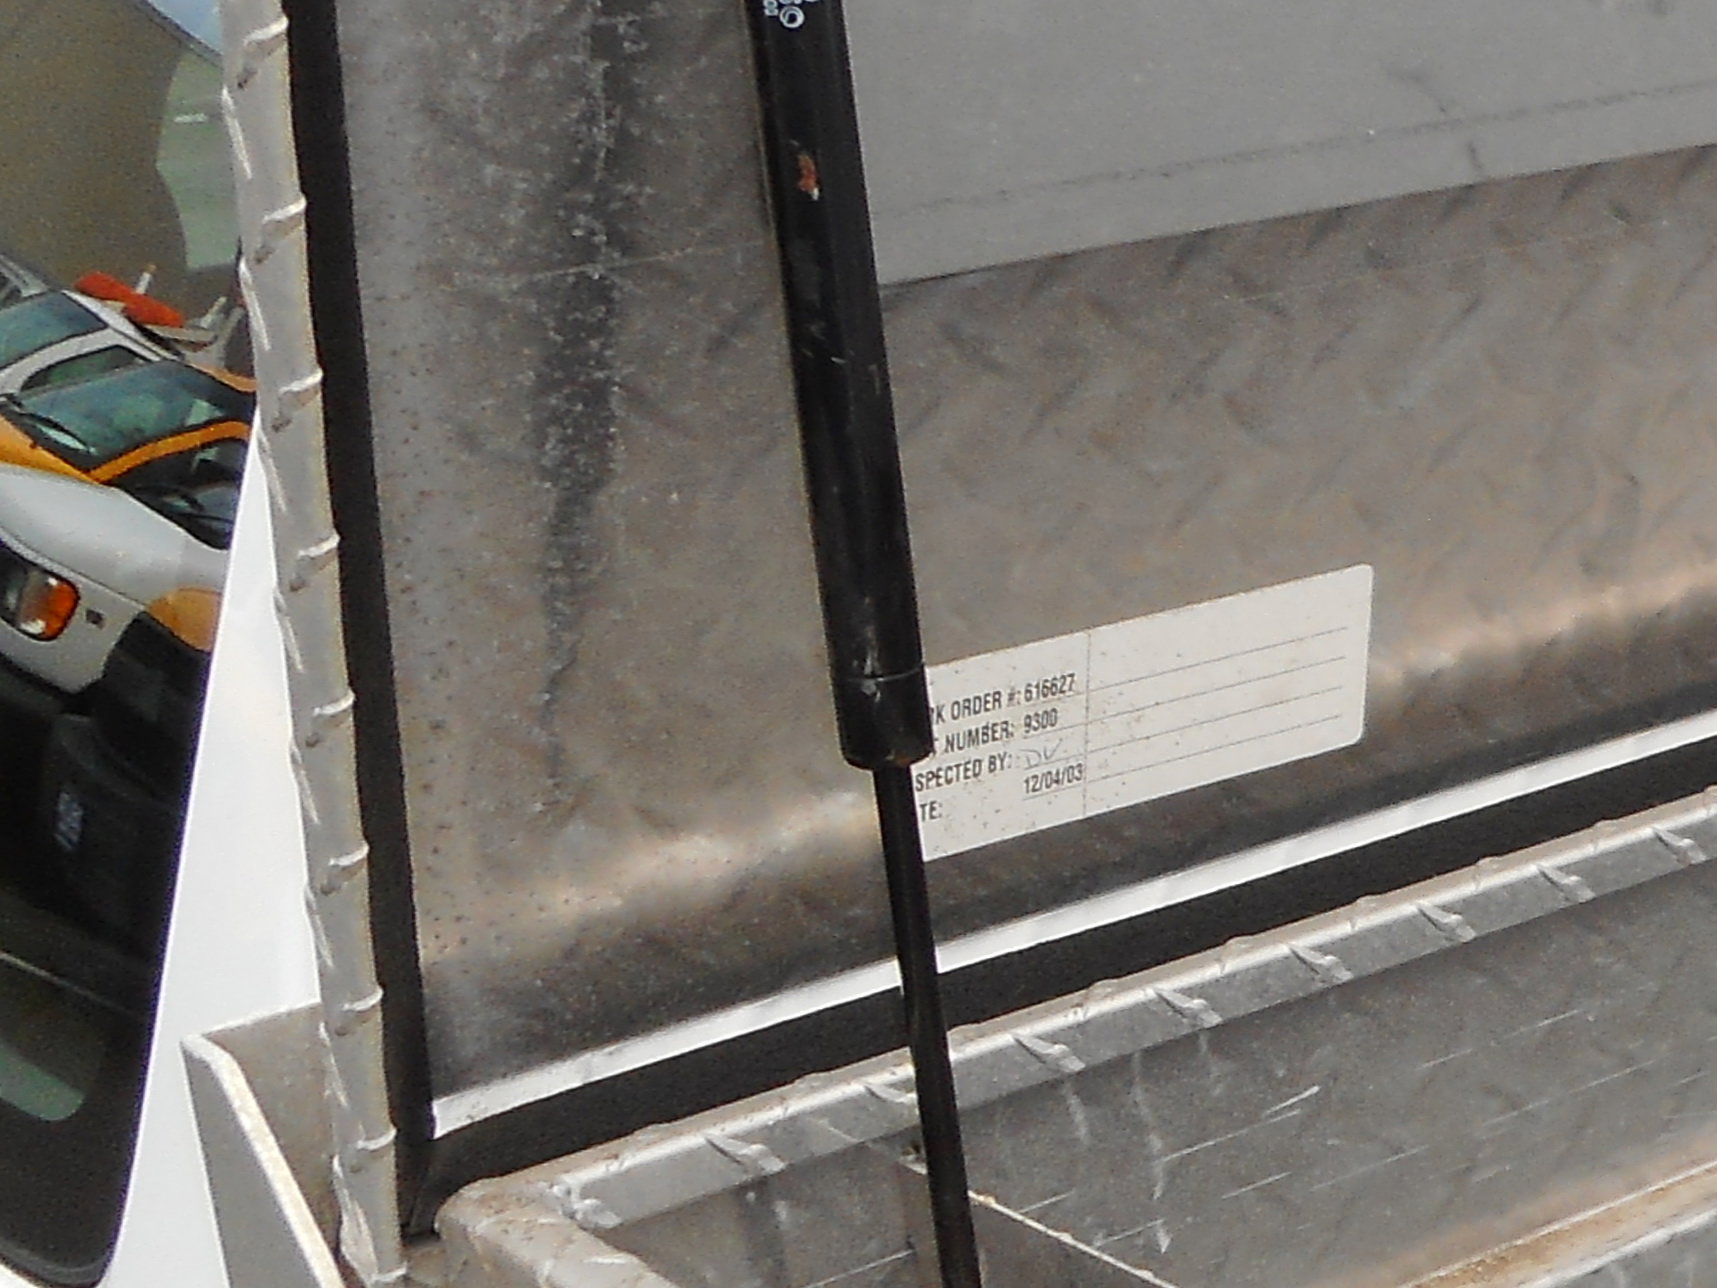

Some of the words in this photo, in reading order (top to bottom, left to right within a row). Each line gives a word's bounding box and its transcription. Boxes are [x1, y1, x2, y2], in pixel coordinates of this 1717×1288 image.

[950, 690, 1002, 721] ORDER
[1023, 672, 1076, 702] 616627
[944, 720, 1015, 753] NUMBER:
[1023, 708, 1058, 733] 9300
[914, 758, 983, 792] SPECTED
[987, 751, 1012, 773] BY:
[919, 800, 943, 822] TE:
[1023, 763, 1084, 794] 12/04/03
